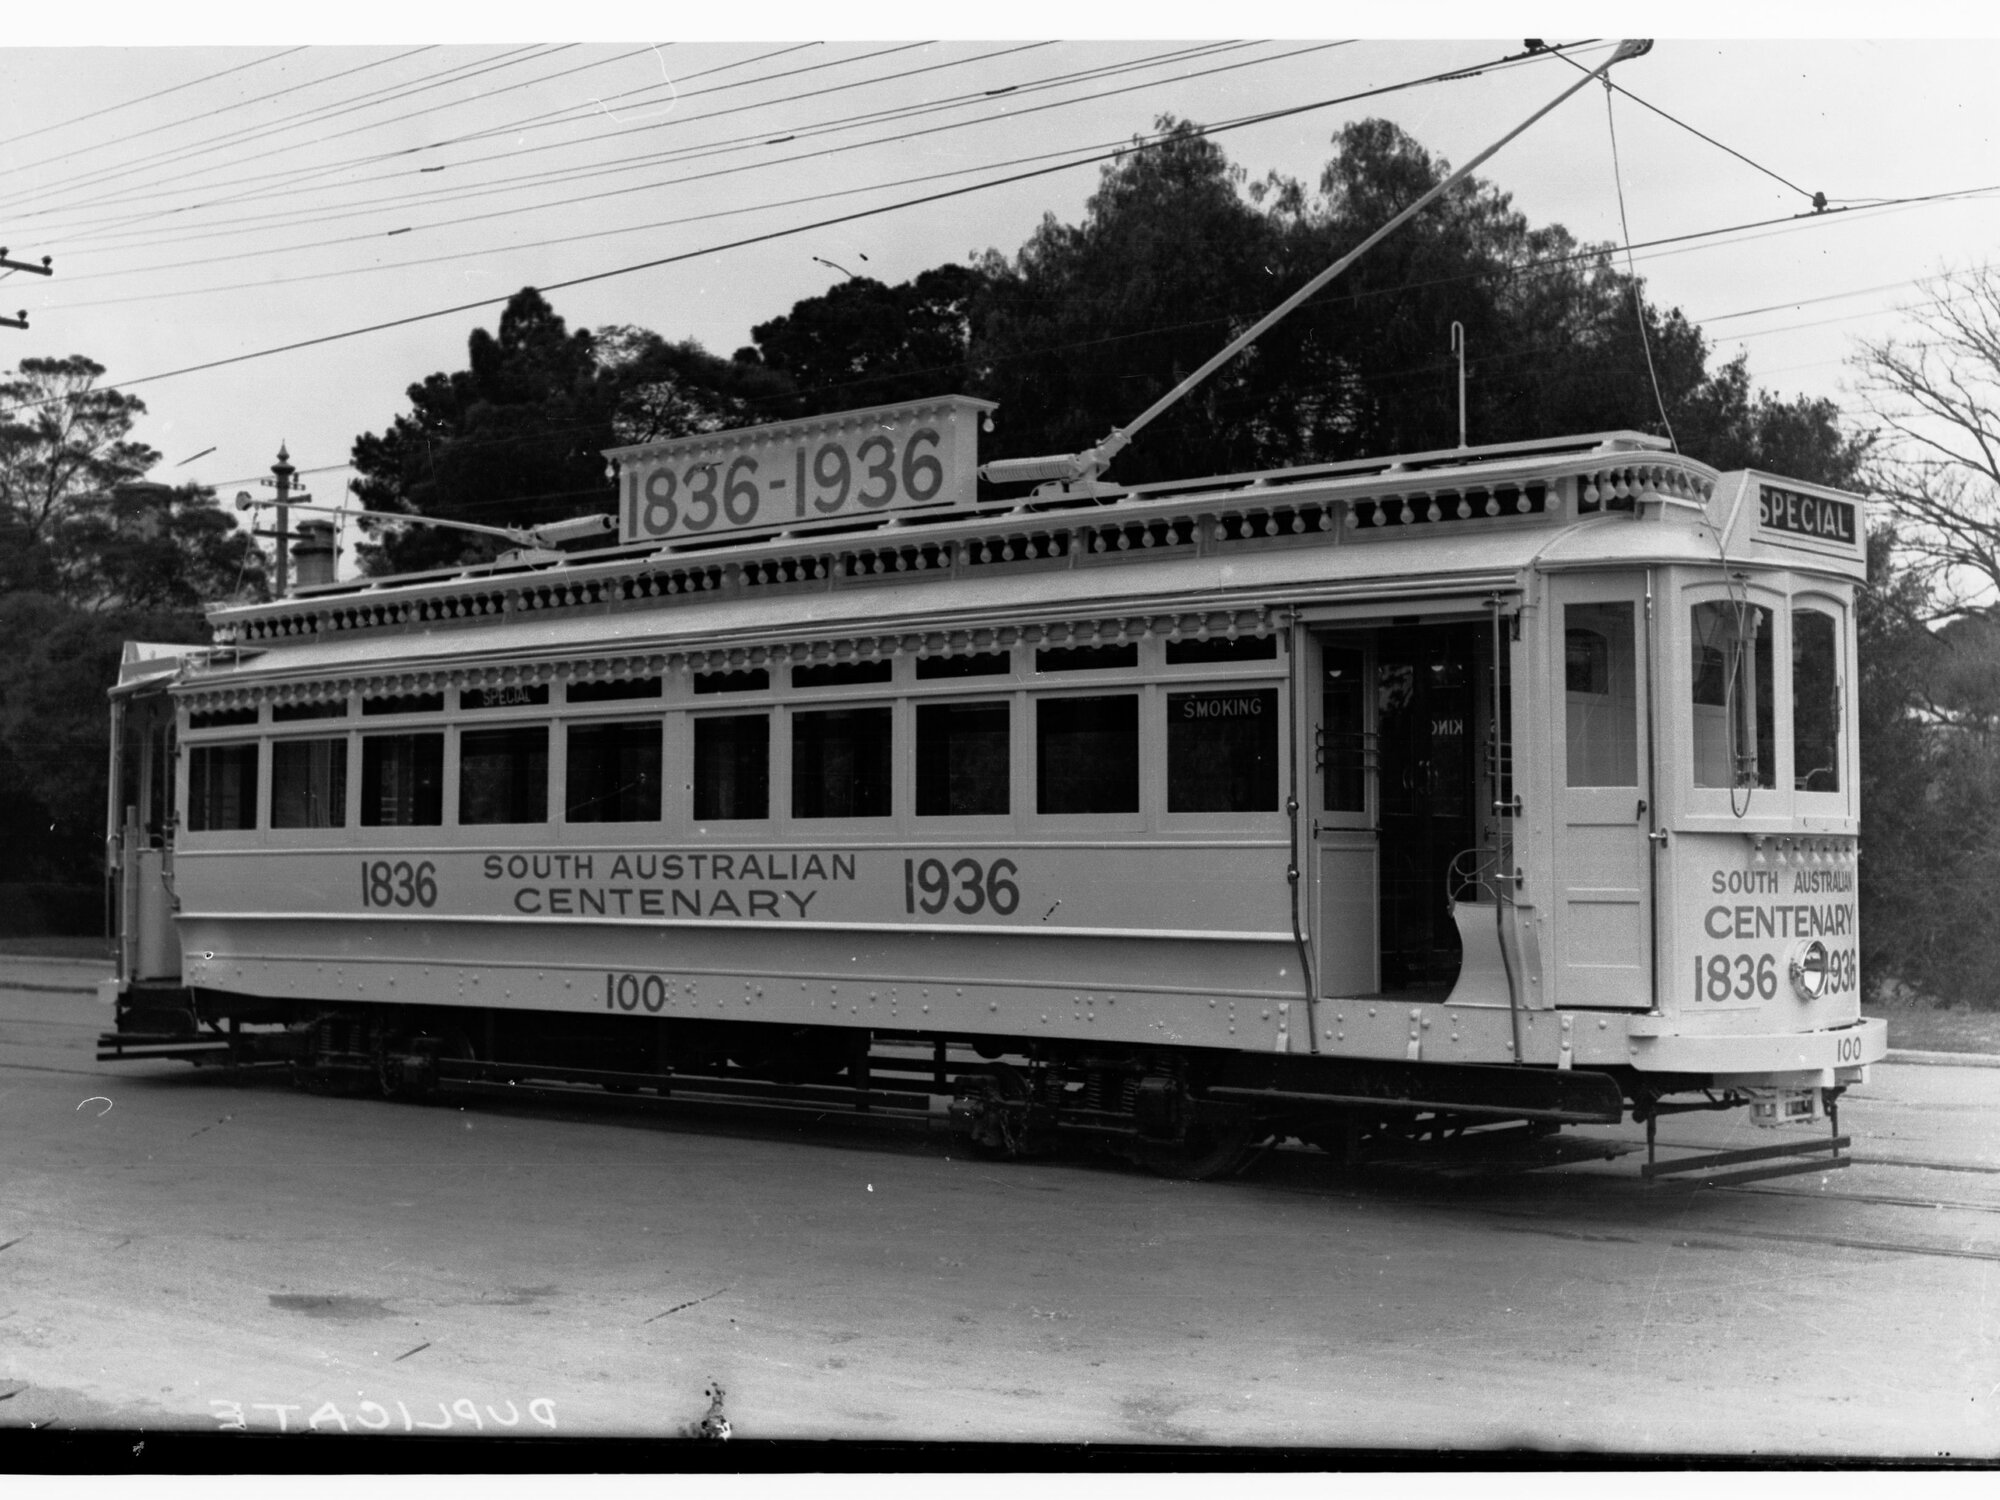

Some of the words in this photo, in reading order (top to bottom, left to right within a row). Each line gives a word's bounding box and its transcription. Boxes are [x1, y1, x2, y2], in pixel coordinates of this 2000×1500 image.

[628, 427, 944, 539] 1836-1936
[1760, 490, 1850, 538] SPECIAL
[1183, 698, 1262, 719] SMOKING
[361, 860, 438, 908] 1836
[483, 854, 593, 880] SOUTH
[610, 853, 856, 881] AUSTRALIAN
[1711, 869, 1779, 894] SOUTH
[1793, 870, 1853, 894] AUSTRALIAN
[513, 887, 818, 918] CENTENARY
[904, 857, 1020, 916] 1936
[1704, 903, 1855, 940] CENTENARY
[606, 973, 666, 1013] 100
[1694, 952, 1778, 1002] 1836
[1837, 1036, 1862, 1063] 100
